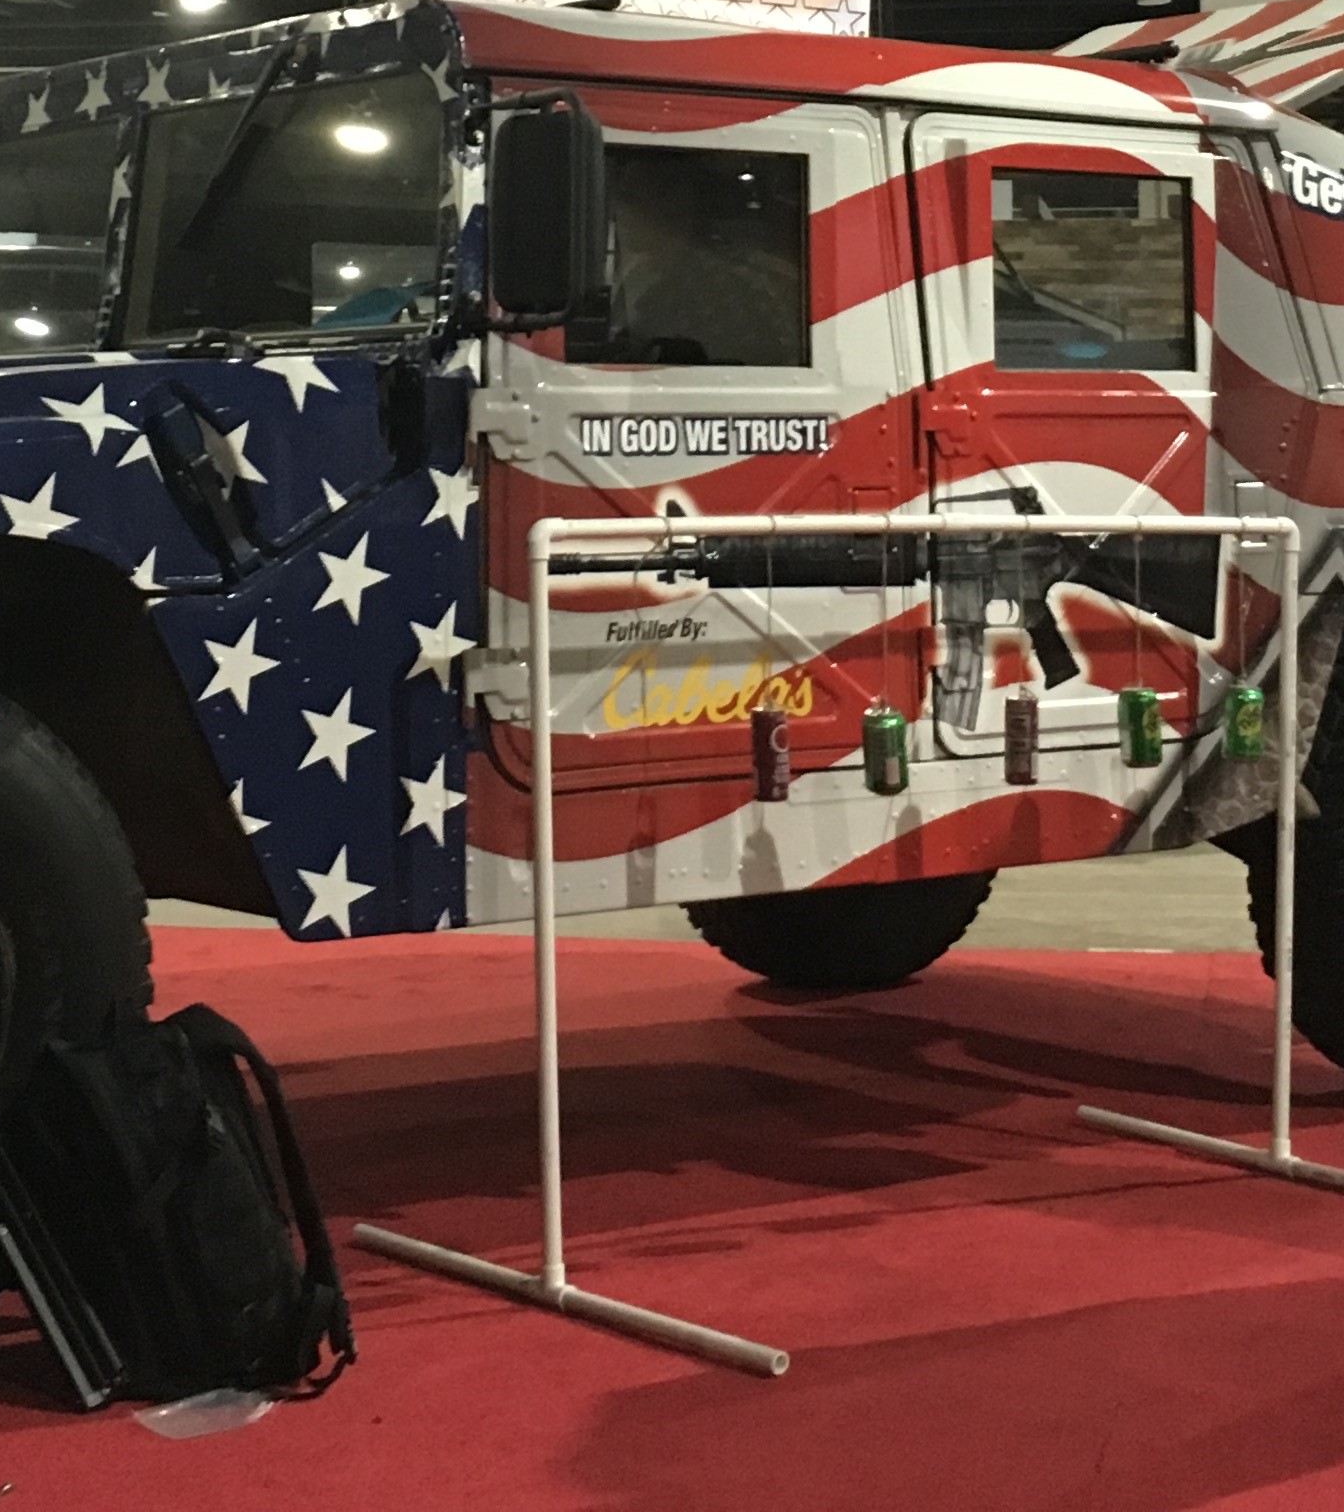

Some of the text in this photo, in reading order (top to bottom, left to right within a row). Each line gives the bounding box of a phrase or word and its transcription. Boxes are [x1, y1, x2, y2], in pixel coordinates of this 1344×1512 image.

[582, 419, 829, 453] IN GOD WE TRUST!
[680, 618, 707, 641] By:
